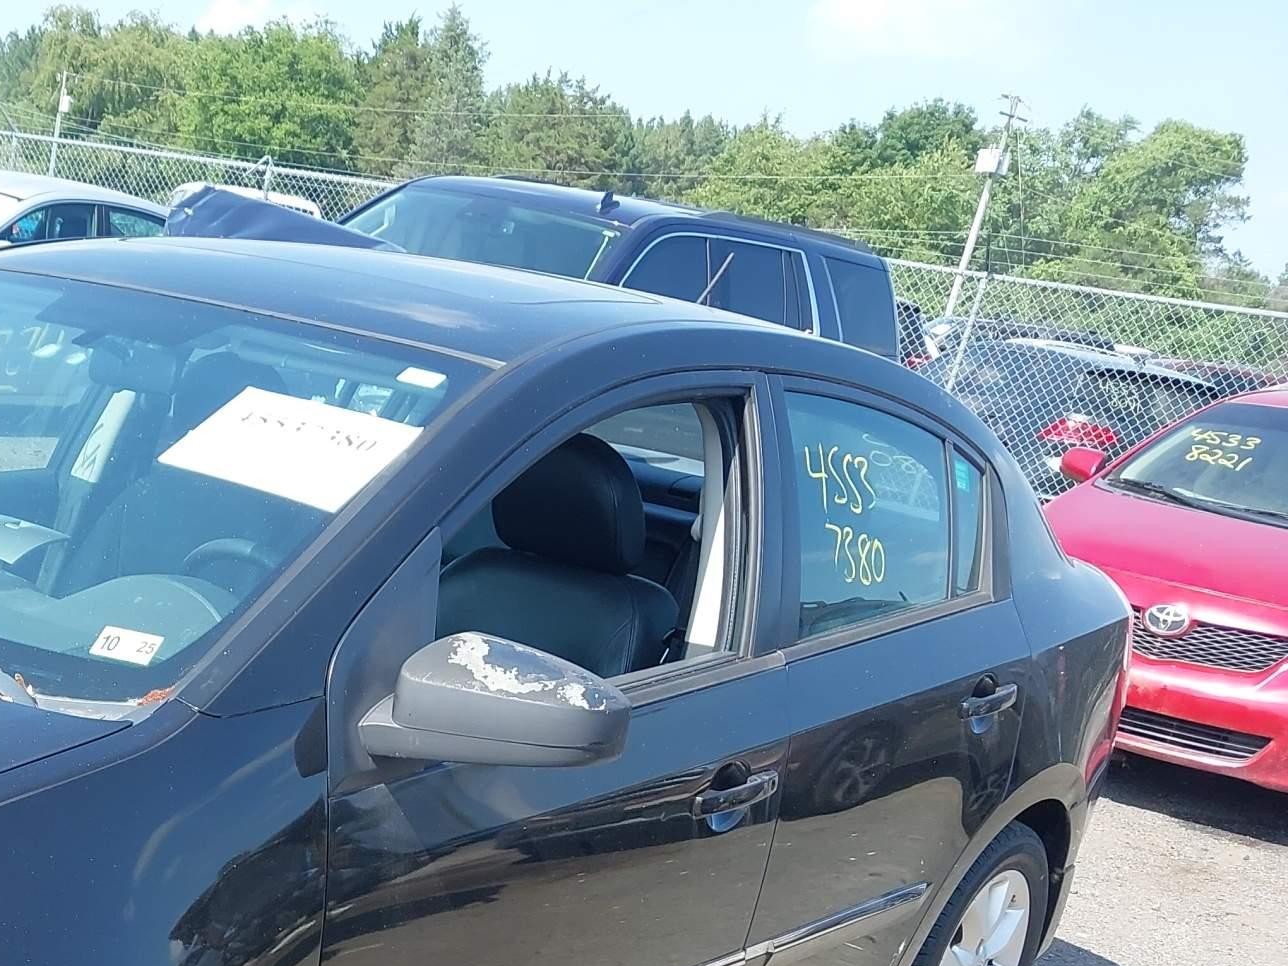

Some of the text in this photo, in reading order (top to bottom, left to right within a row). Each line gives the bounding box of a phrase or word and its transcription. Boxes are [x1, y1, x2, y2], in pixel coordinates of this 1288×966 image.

[1191, 427, 1261, 450] 4533
[1185, 445, 1253, 472] 8221
[804, 442, 877, 514] 4553
[825, 522, 885, 586] 7380
[100, 634, 157, 655] 10 25
